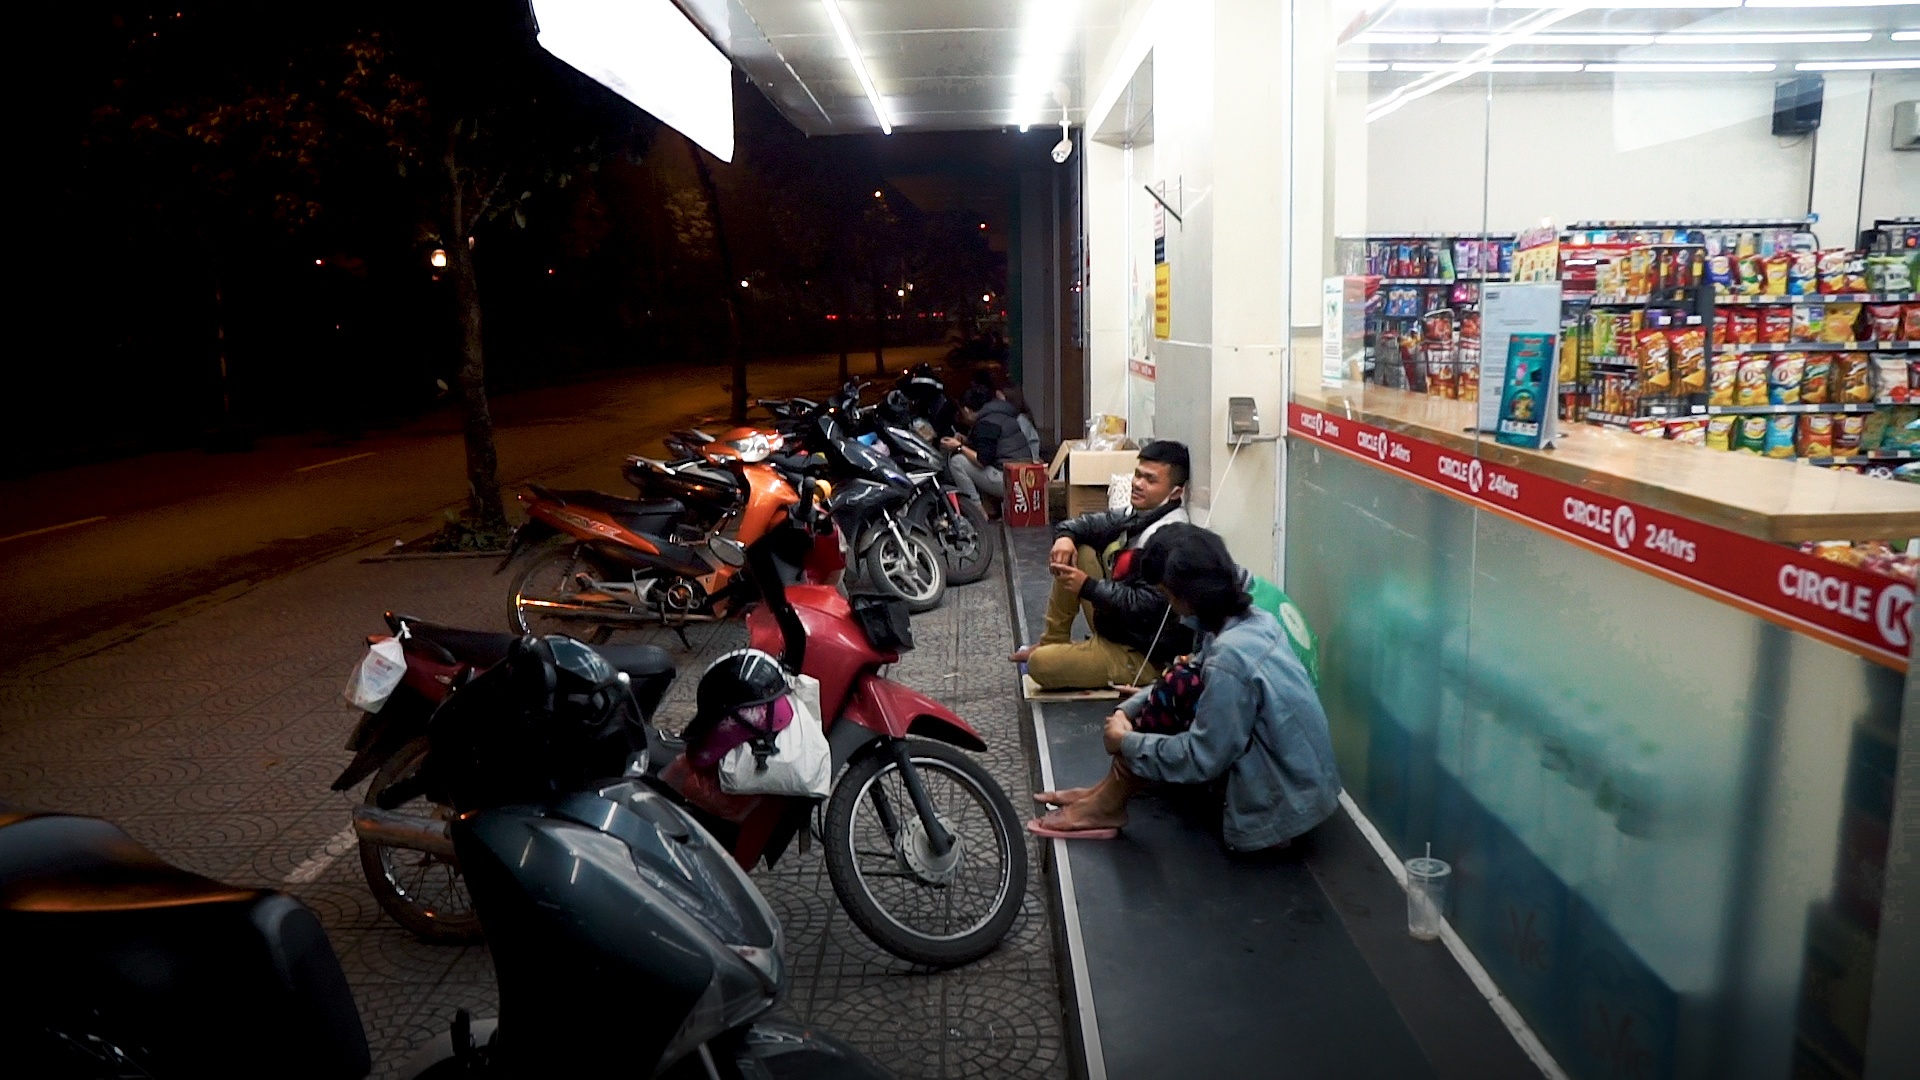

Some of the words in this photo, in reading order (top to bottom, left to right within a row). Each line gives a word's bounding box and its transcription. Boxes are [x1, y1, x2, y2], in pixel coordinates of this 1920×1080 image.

[1301, 412, 1316, 428] CIRCLE
[1357, 431, 1379, 453] CIRCLE
[1378, 432, 1388, 460] K
[1391, 442, 1411, 463] 24hrs
[1438, 455, 1468, 482] CIRCLE
[1468, 459, 1483, 493] K
[1488, 472, 1519, 500] 24hrs
[1563, 496, 1612, 534] CIRCLE
[1612, 504, 1636, 549] K
[1645, 524, 1696, 563] 24hrs
[1778, 564, 1873, 622] CIRCLE
[1875, 584, 1914, 647] K
